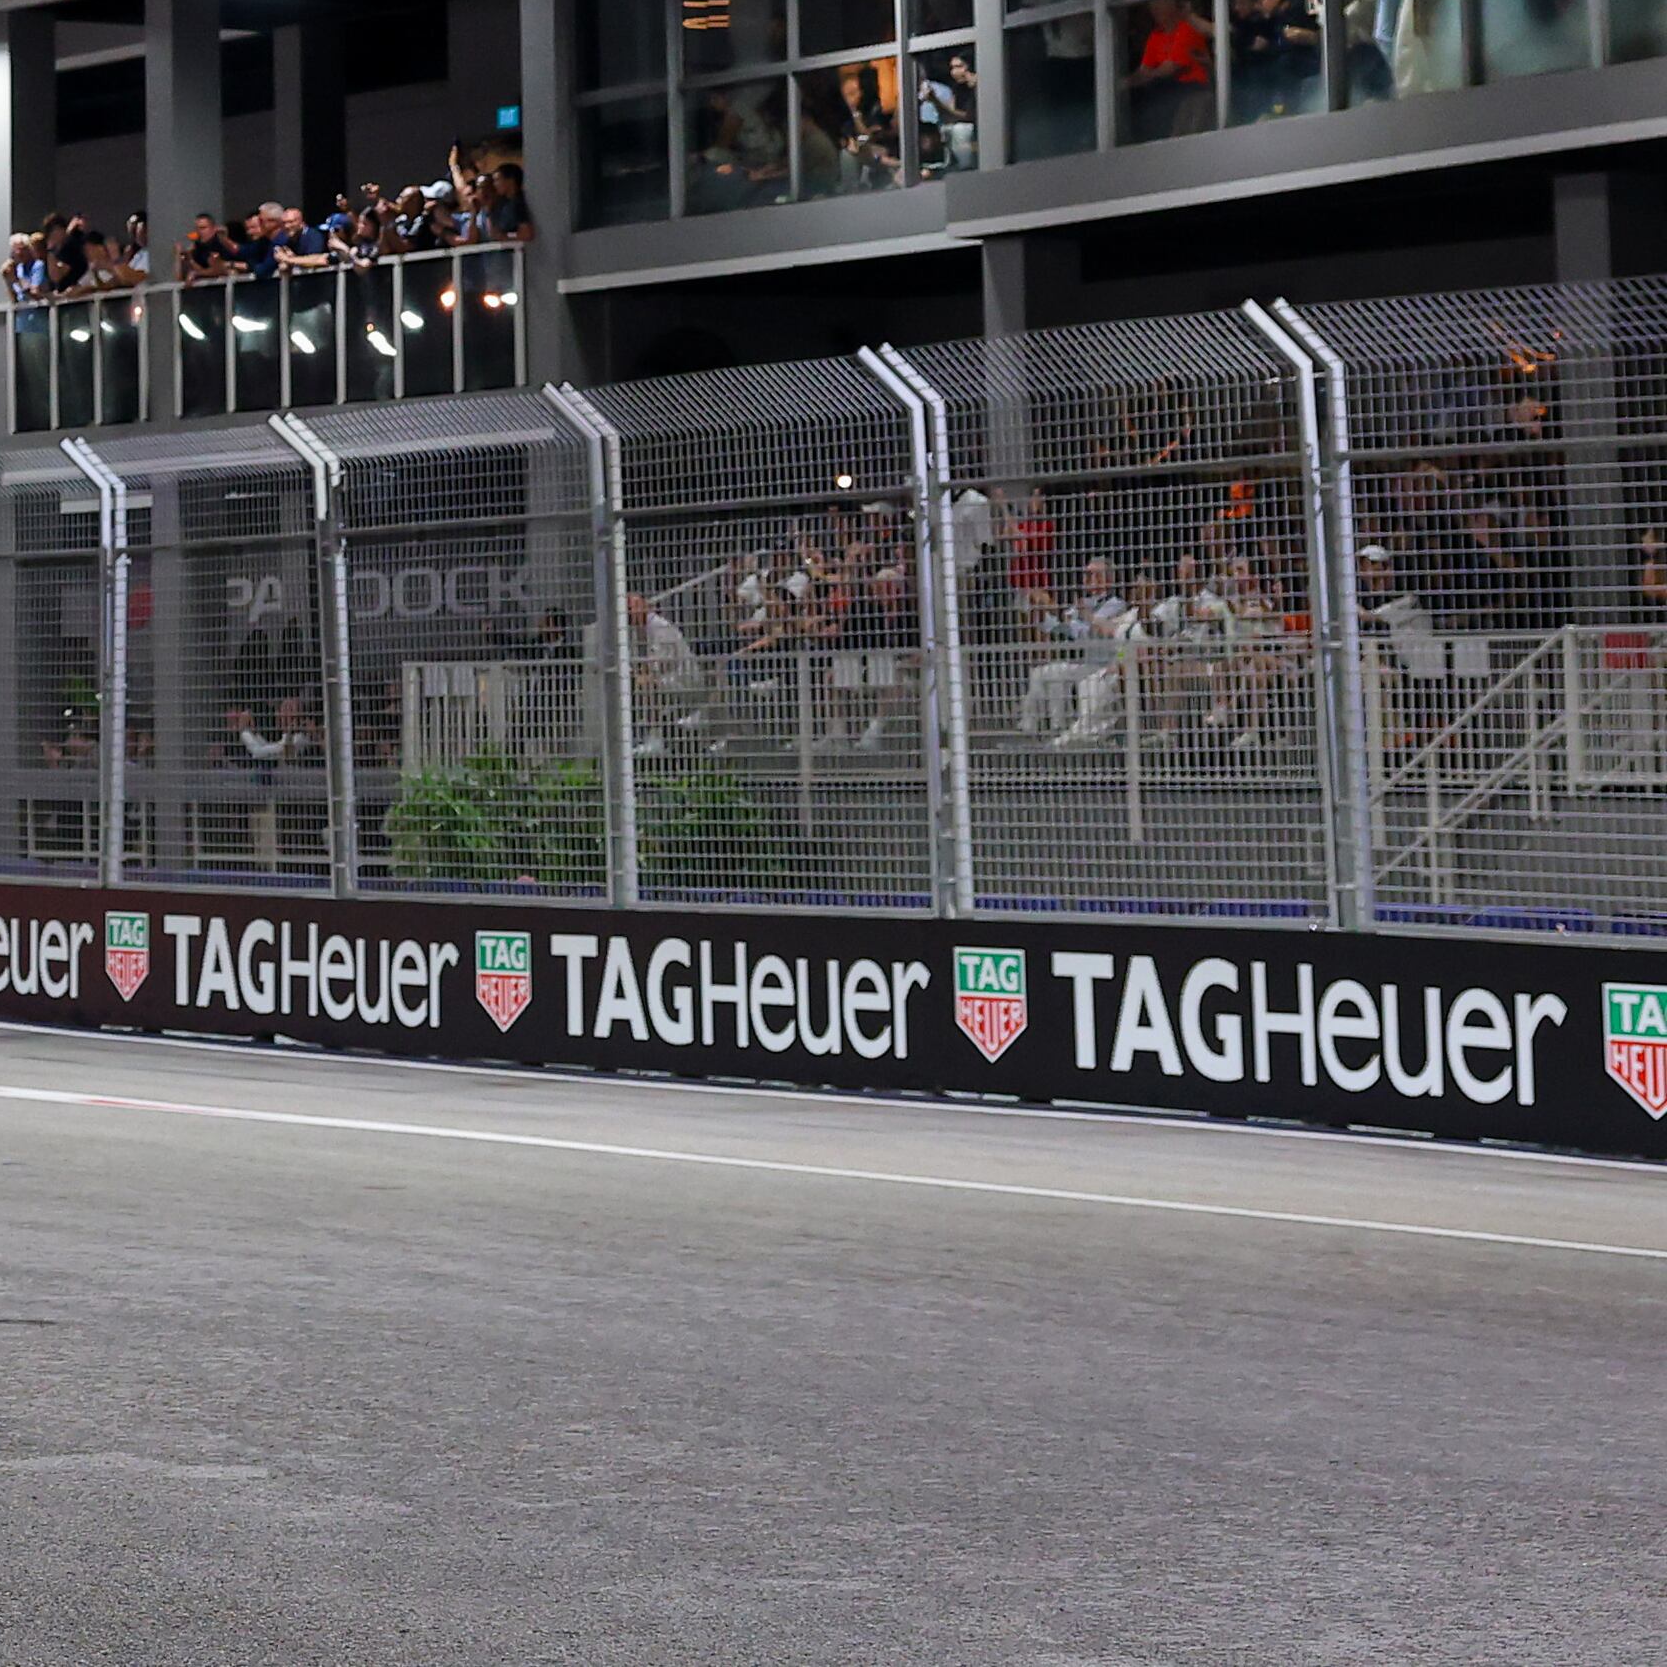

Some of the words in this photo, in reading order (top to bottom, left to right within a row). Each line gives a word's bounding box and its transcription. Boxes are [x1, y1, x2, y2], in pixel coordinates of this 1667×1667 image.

[108, 918, 144, 946] TAG
[481, 938, 525, 969] TAG
[162, 914, 460, 1030] TAGHeuer
[550, 934, 931, 1061] TAGHeuer
[960, 956, 1019, 991] TAG
[959, 1000, 1023, 1052] HEUER
[1051, 951, 1570, 1107] TAGHeuer
[1610, 992, 1667, 1036] TA
[1610, 1043, 1667, 1105] HEU
